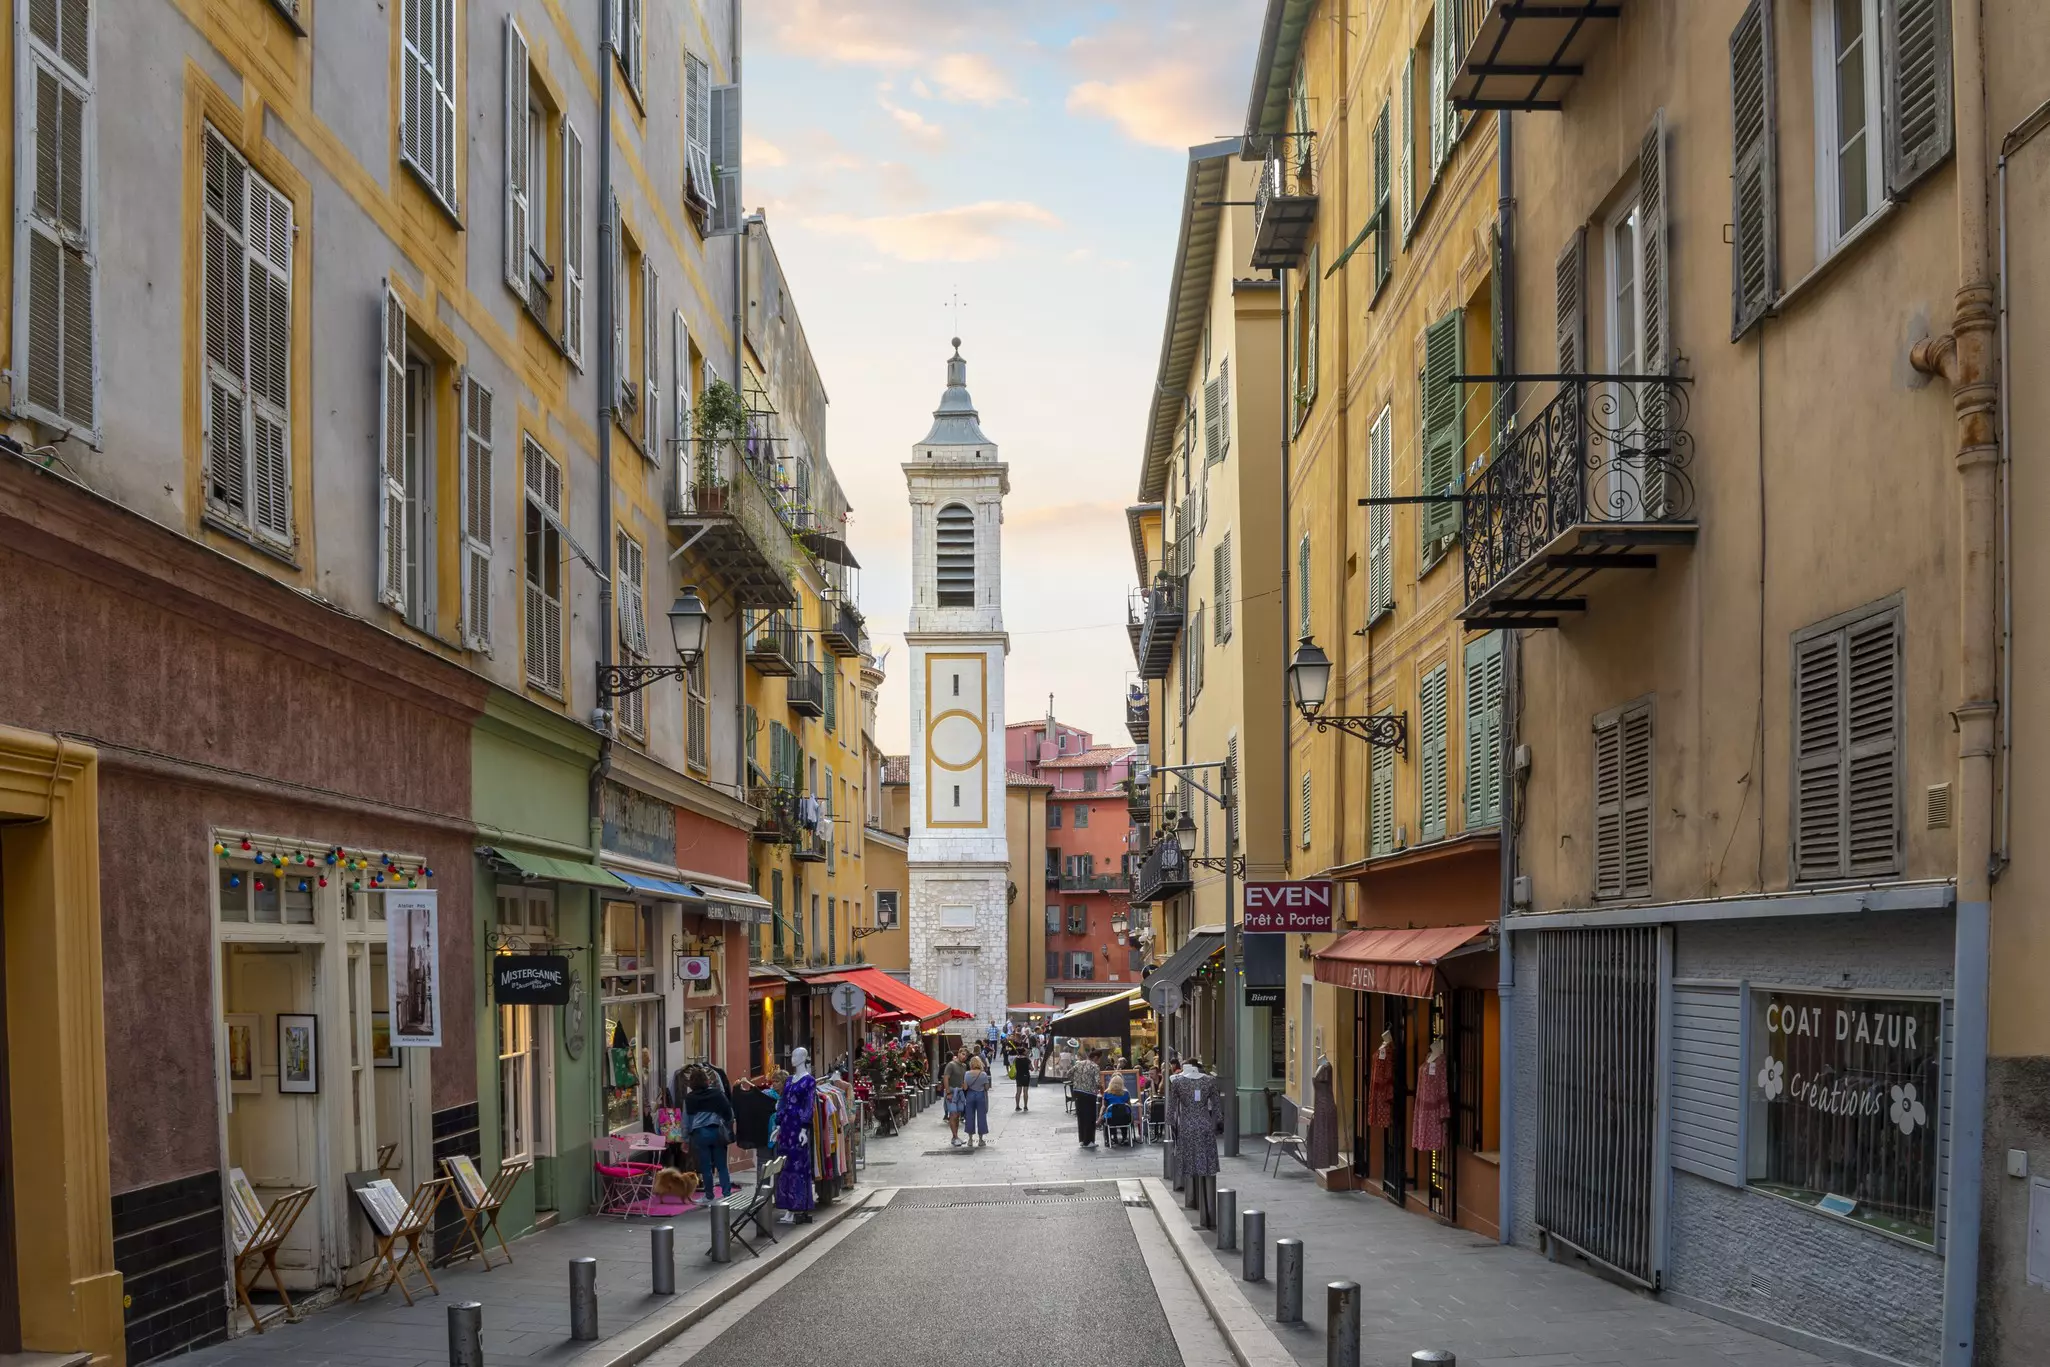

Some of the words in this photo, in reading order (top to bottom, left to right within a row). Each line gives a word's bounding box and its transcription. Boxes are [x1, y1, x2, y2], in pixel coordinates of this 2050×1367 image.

[1246, 886, 1329, 907] EVEN
[1245, 913, 1272, 926] Prêt
[1276, 912, 1284, 926] à
[1289, 913, 1331, 926] Porter
[1352, 967, 1375, 987] EVEN
[1251, 993, 1278, 1001] Bistrot
[1766, 1004, 1822, 1038] COAT
[1836, 1010, 1918, 1050] D'AZUR
[1790, 1072, 1884, 1117] Créations
